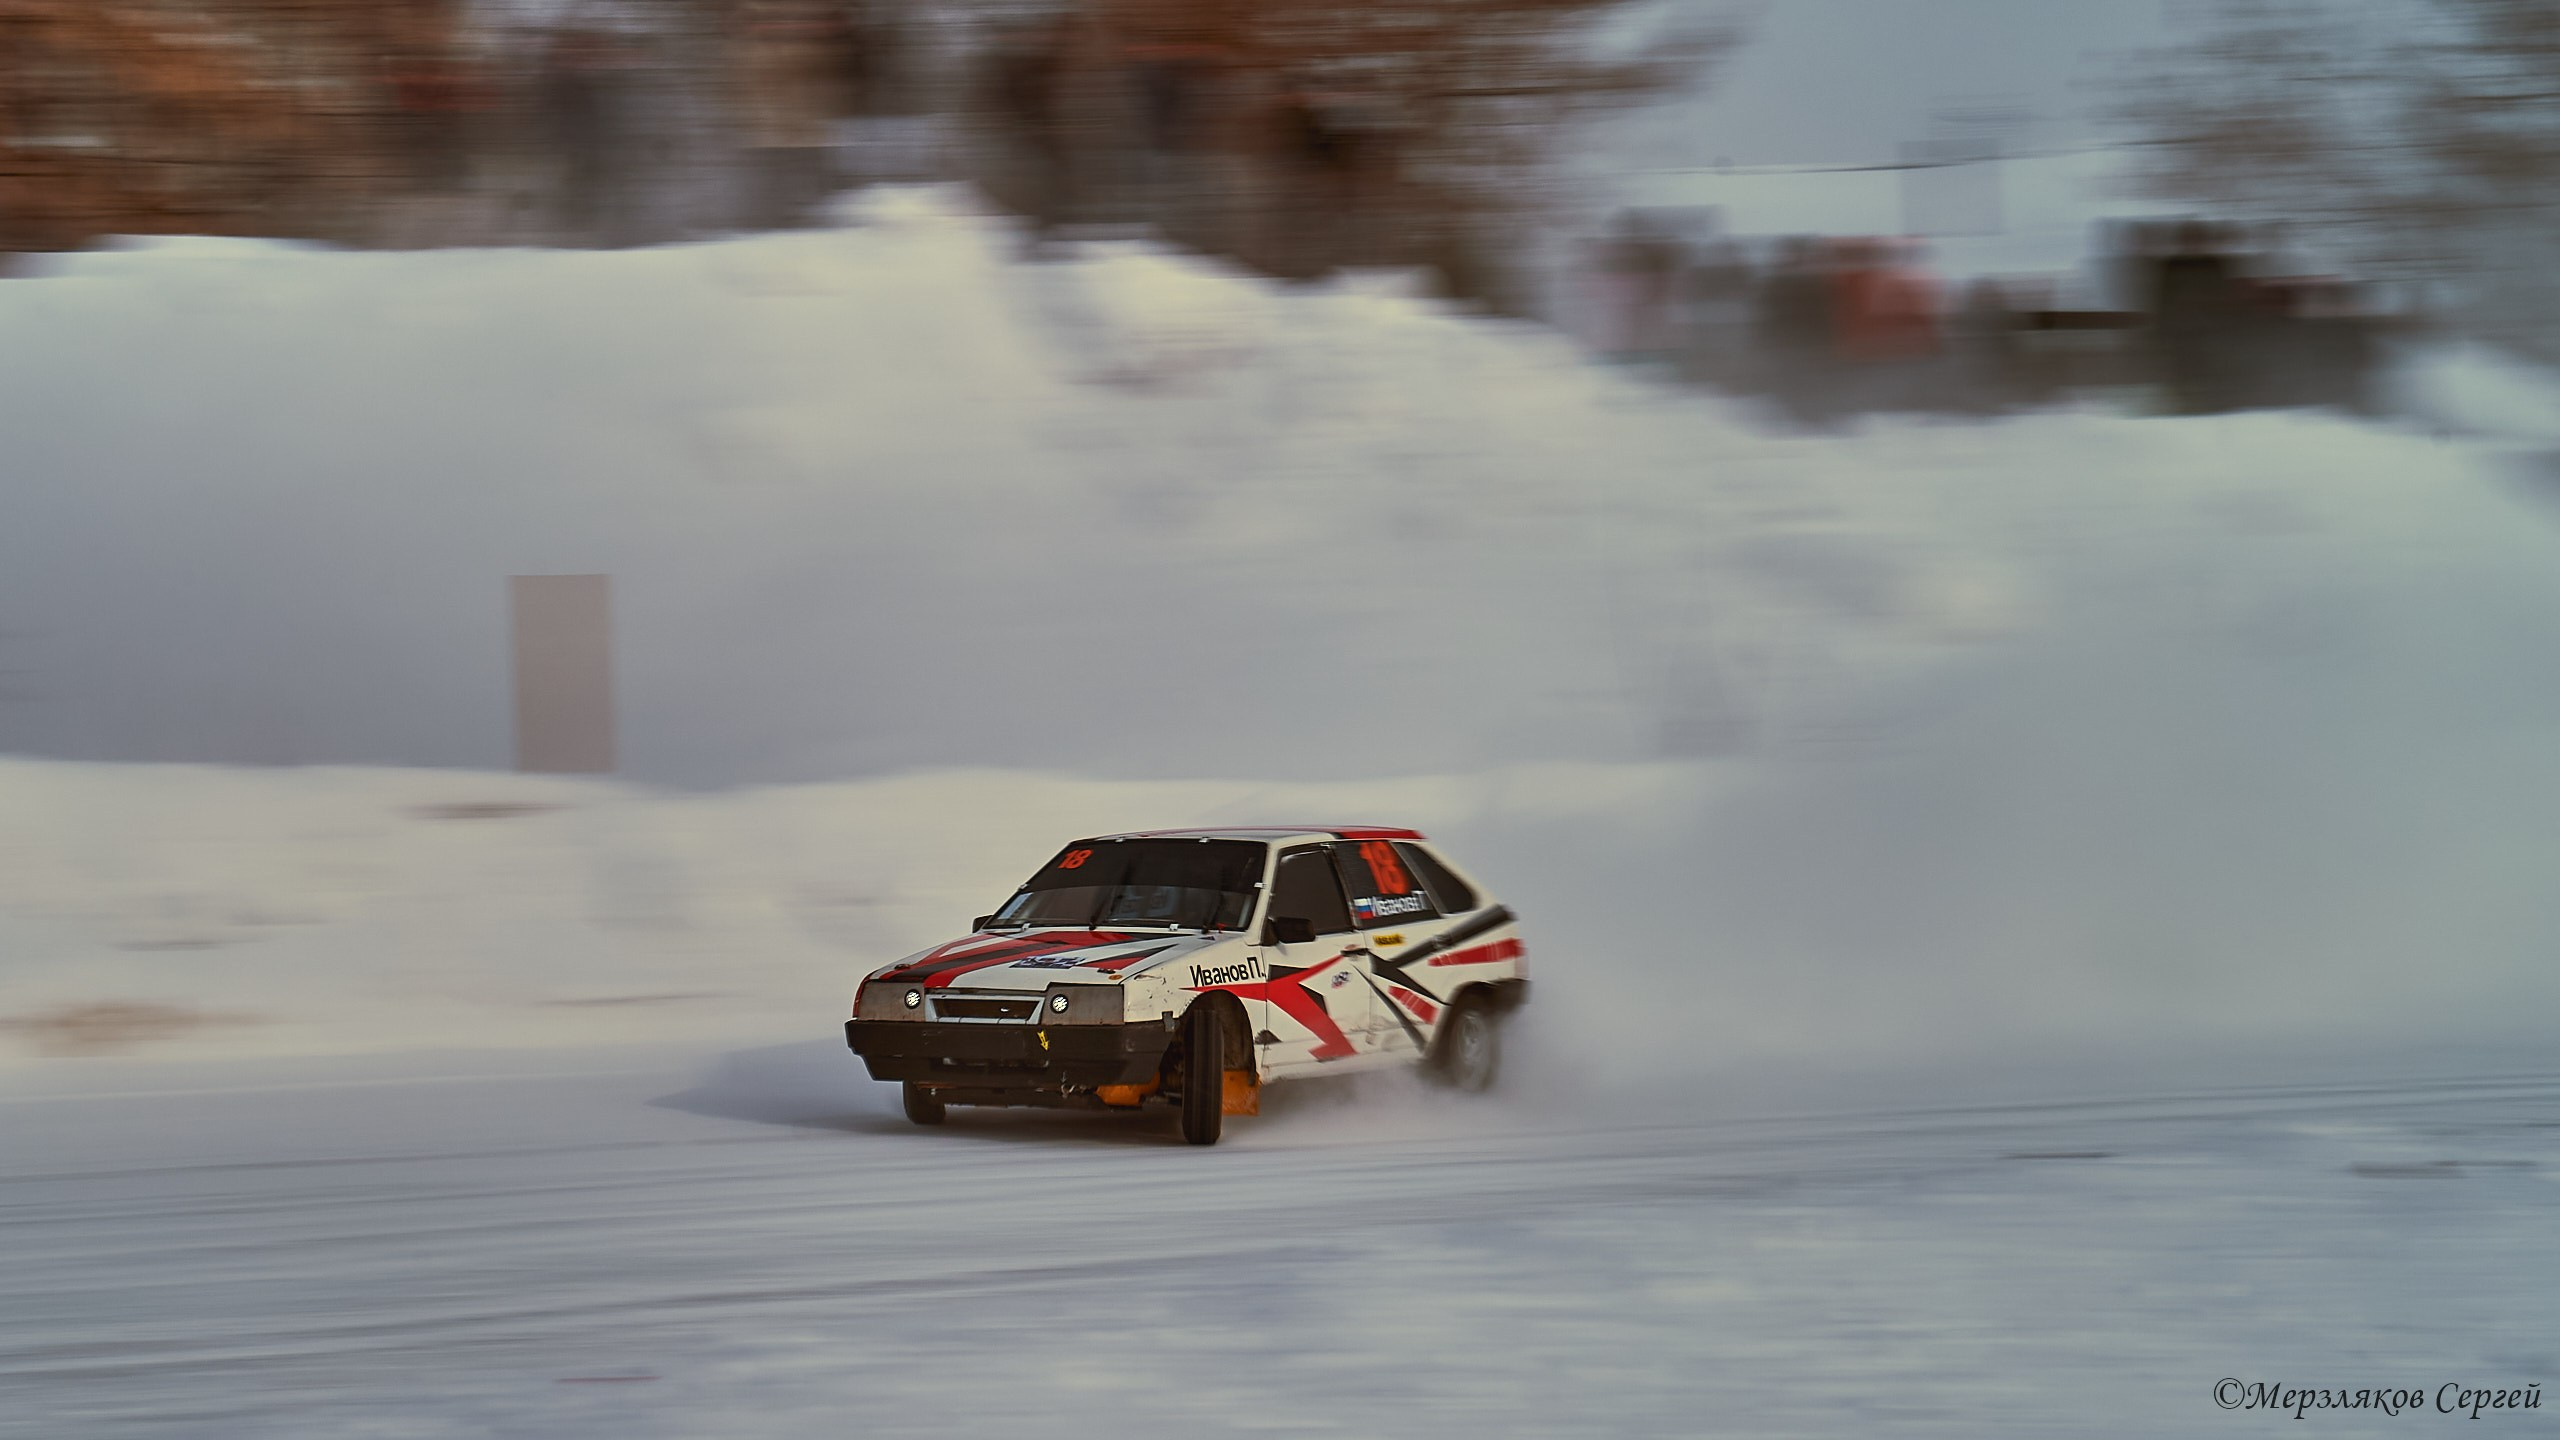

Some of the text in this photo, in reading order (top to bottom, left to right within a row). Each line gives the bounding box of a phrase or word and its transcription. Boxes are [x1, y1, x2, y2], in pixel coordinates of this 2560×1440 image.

[1058, 849, 1094, 869] 18
[1360, 840, 1411, 895] 18
[1189, 963, 1249, 988] Иванов
